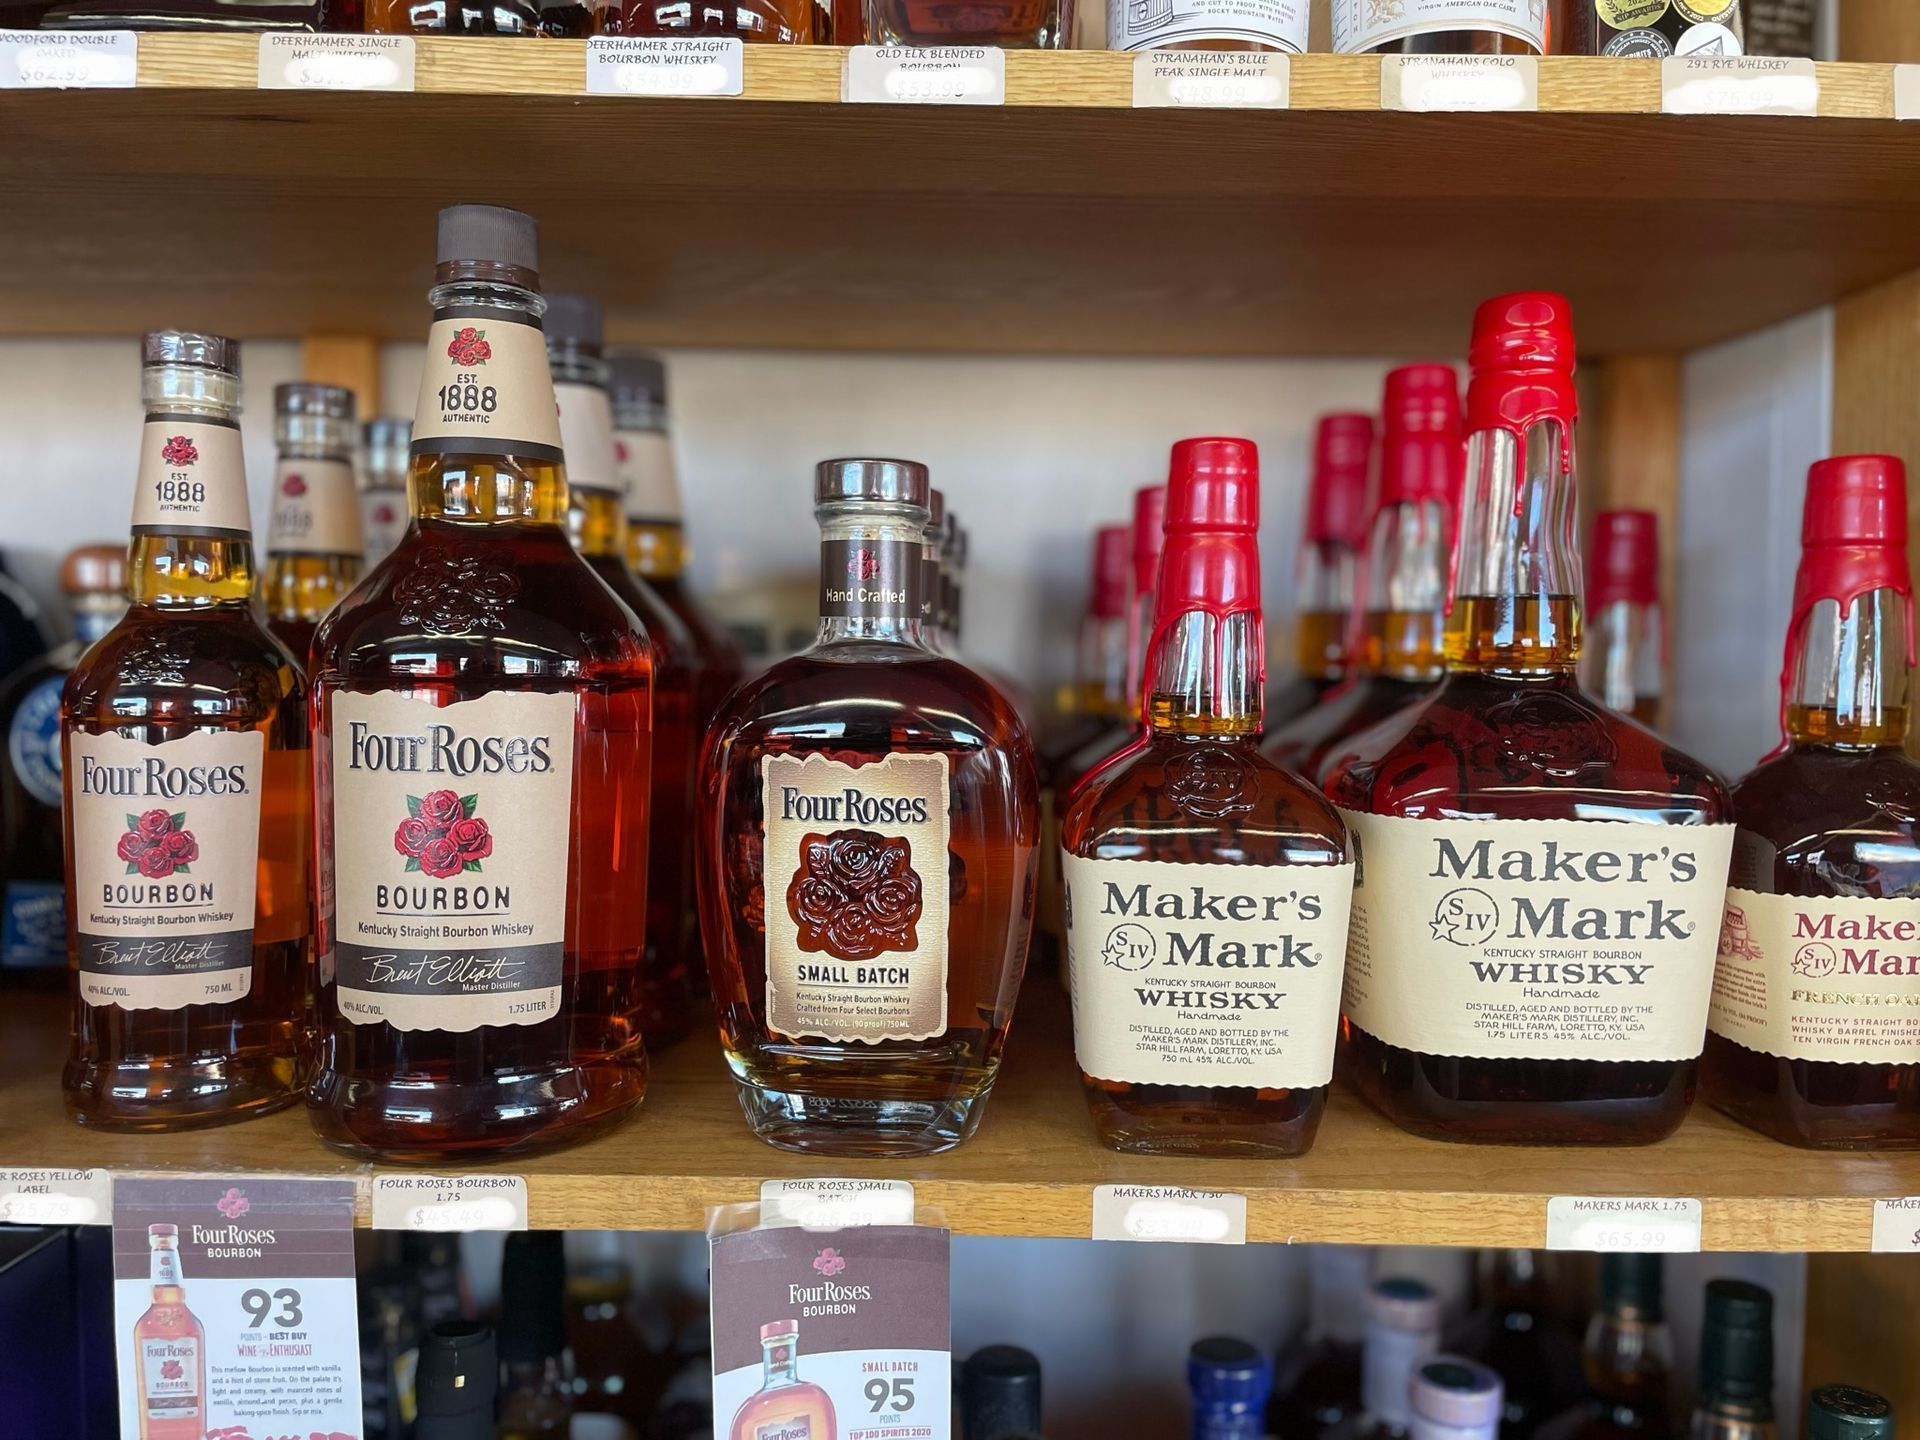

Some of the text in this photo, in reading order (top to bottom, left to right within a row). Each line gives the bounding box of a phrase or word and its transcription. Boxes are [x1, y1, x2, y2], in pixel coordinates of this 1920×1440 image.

[1233, 9, 1265, 18] MOUNTAIN
[1499, 4, 1516, 12] CASKS
[70, 35, 118, 44] DOUBLE
[272, 36, 401, 48] DEERHAMMER SINGLE
[671, 42, 732, 52] STRAIGHT
[599, 54, 716, 65] BOURBON WHISKEY
[876, 50, 985, 59] OLD ELK BLENDED
[1152, 53, 1269, 64] STRANAHAN'S BLUE
[1483, 58, 1515, 67] COLO
[1687, 60, 1790, 70] 291 RYE WHISKEY
[1154, 68, 1266, 77] PEAK SINGLE MALT
[457, 374, 477, 384] EST.
[438, 384, 497, 413] 1888
[442, 413, 490, 424] AUTHENTIC
[156, 481, 205, 502] 1888
[827, 588, 905, 603] Hand Crafted
[1428, 837, 1697, 884] Maker's
[103, 882, 213, 904] BOURBON
[376, 885, 510, 910] BOURBON
[1100, 881, 1322, 921] Maker's
[90, 912, 234, 926] Kentucky Straight Bourbon Whiskey
[1506, 896, 1690, 941] Mark
[359, 922, 534, 939] Kentucky Straight Bourbon Whiskey
[1792, 912, 1920, 942] Make
[1163, 931, 1319, 969] Mark
[1483, 948, 1642, 960] KENTUCKY STRAIGHT BOURBON
[798, 965, 909, 984] SMALL BATCH
[1469, 961, 1654, 985] WHISKY
[462, 981, 521, 992] Master Distiller
[1145, 977, 1276, 989] KENTUCKY STRAIGHT BOURBON
[205, 985, 232, 995] 750 ML
[1523, 987, 1600, 999] Handmade
[796, 992, 910, 1004] Kentucky Straight Bourbon Whiskey
[1133, 988, 1287, 1010] WHISKY
[508, 1001, 546, 1014] 1.75 LITER
[796, 1004, 821, 1013] Crafted
[1177, 1010, 1242, 1021] Handmade
[1791, 1015, 1902, 1026] KENTUCKY STRAIGHT
[1129, 1024, 1172, 1034] DISTILLED,
[1174, 1026, 1197, 1036] AGED
[1199, 1028, 1217, 1036] AND
[1220, 1029, 1259, 1037] BOTTLED
[1487, 1031, 1506, 1039] 1.75
[1510, 1032, 1549, 1040] LITERS
[1554, 1032, 1575, 1040] 45%
[1791, 1025, 1877, 1036] WHISKY BARREL
[1142, 1035, 1276, 1047] MAKER'S MARK DISTILLERY, INC.
[1792, 1036, 1812, 1044] TEN
[1817, 1037, 1850, 1045] VIRGIN
[1853, 1038, 1891, 1046] FRENCH
[1136, 1043, 1282, 1056] STAR HILL FARM, LORETTO, USA
[1162, 1054, 1176, 1063] 750
[1196, 1056, 1213, 1064] 45%
[10, 1172, 93, 1180] ROSES YELLOW
[18, 1185, 51, 1193] LABEL
[380, 1179, 516, 1189] FOUR ROSES BOURBON
[782, 1182, 894, 1191] FOUR ROSES SMALL
[436, 1193, 461, 1201] 1.75
[1113, 1188, 1198, 1199] MAKERS MARK
[1573, 1201, 1688, 1211] MAKERS MARK 1.75
[207, 1248, 262, 1258] BOURBON
[241, 1288, 303, 1328] 93
[803, 1304, 856, 1317] BOURBON
[269, 1332, 307, 1340] BEST BUY
[237, 1344, 312, 1356] WINE ENTHUSIAST
[862, 1362, 918, 1372] SMALL BATCH
[864, 1378, 915, 1413] 95
[880, 1414, 901, 1424] POINTS
[849, 1428, 931, 1440] TOP 100 SPIRITS 2020
